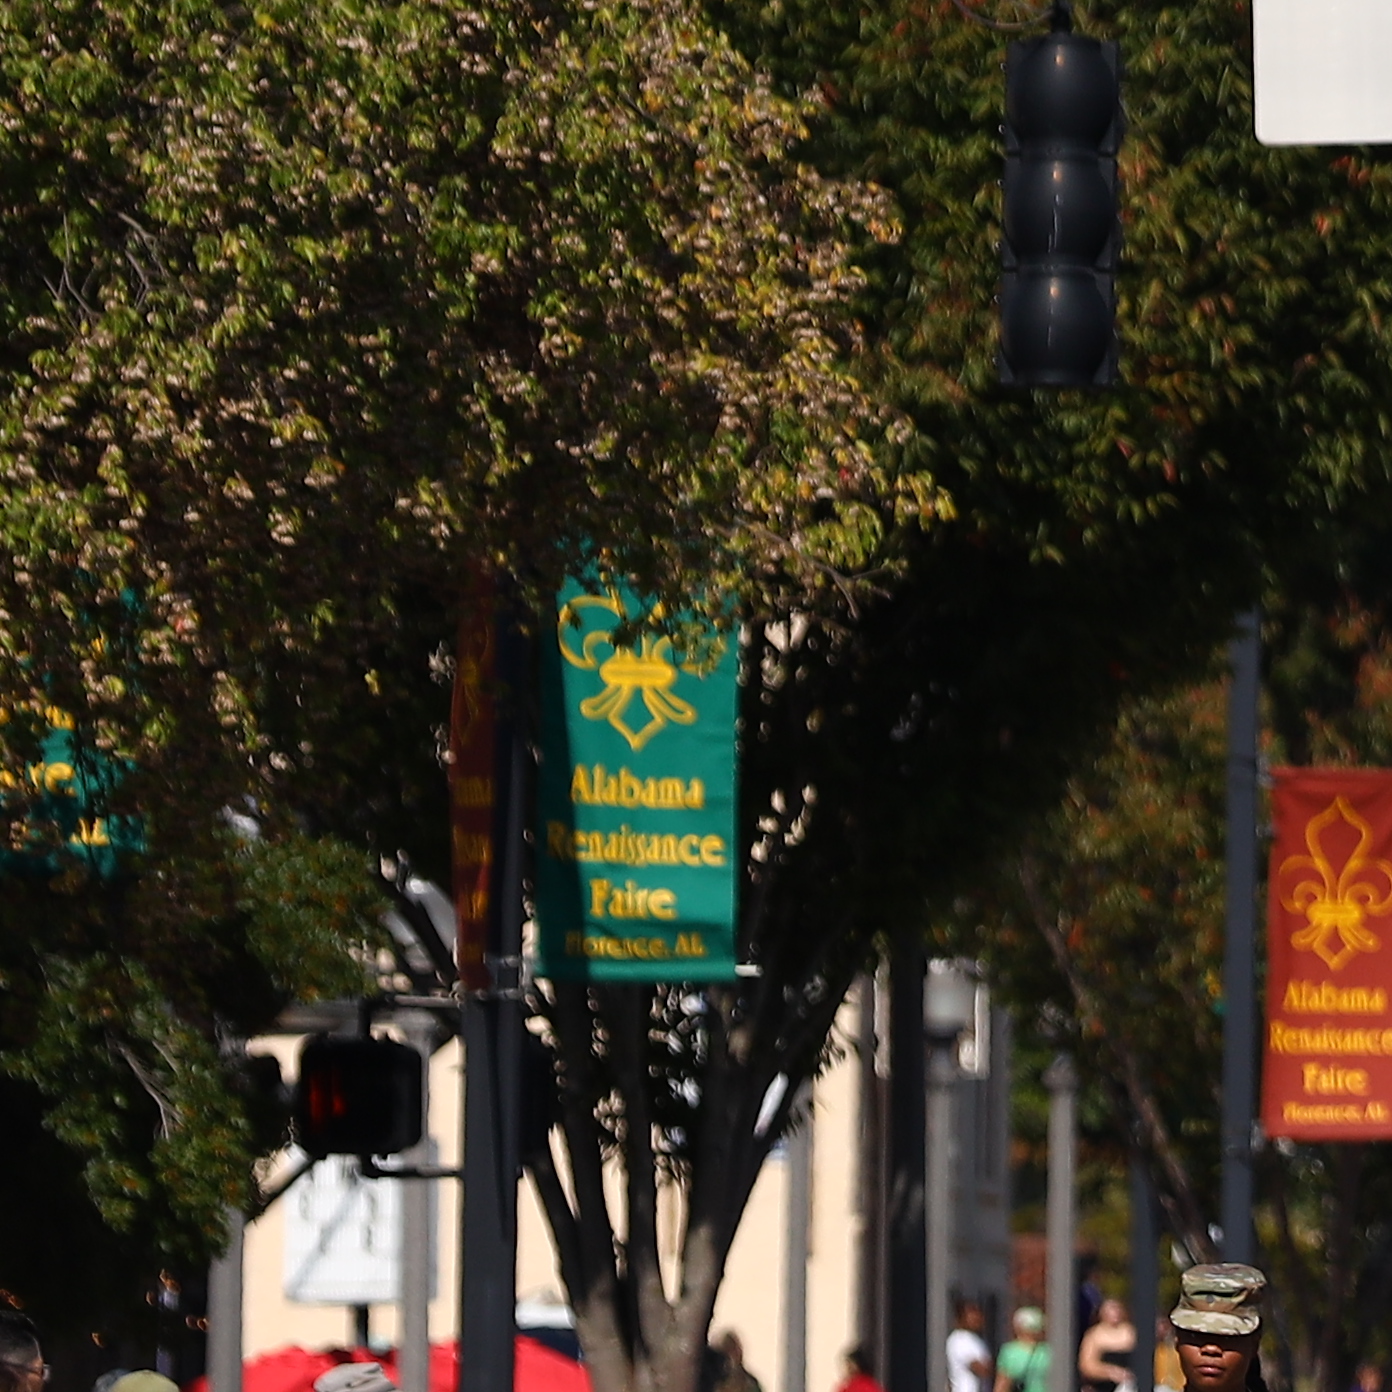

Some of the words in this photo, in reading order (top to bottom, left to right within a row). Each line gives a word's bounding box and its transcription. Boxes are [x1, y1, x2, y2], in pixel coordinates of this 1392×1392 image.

[570, 763, 706, 810] Alabama
[547, 822, 728, 868] Renaissance
[589, 878, 679, 920] Faire
[1282, 980, 1388, 1015] Alabama
[1303, 1061, 1369, 1096] Faire
